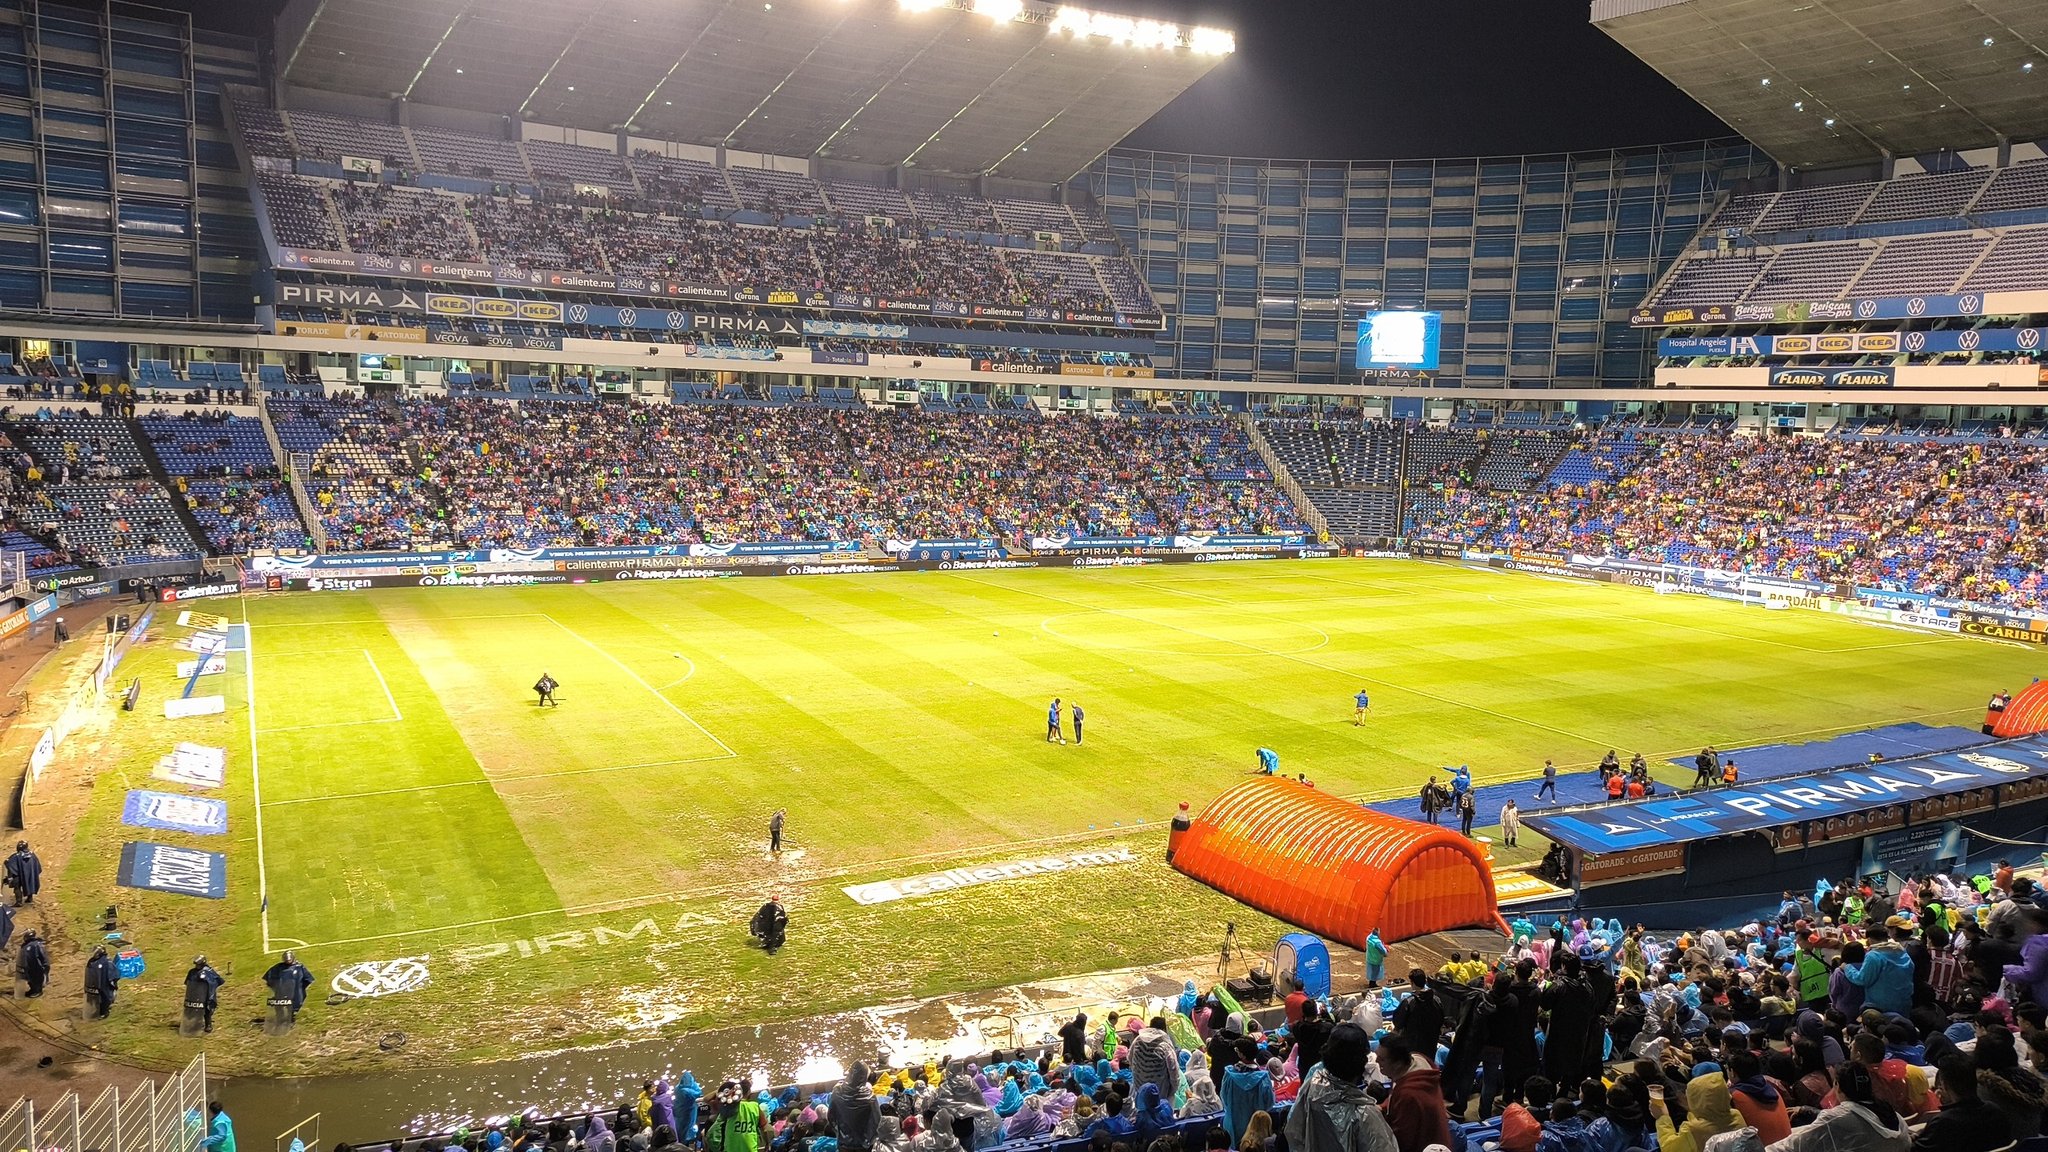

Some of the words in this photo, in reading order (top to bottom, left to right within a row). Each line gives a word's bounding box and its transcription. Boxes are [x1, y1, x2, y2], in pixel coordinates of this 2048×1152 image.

[309, 256, 355, 268] caliente.mx
[433, 263, 492, 281] caliente.mx
[562, 274, 616, 289] caliente.mx
[284, 287, 384, 306] PIRMA
[678, 284, 728, 298] caliente.mx
[735, 292, 760, 301] Corona
[432, 300, 470, 310] IKEA
[805, 297, 830, 306] Corona
[887, 300, 930, 313] caliente.mx
[479, 303, 514, 313] IKEA
[522, 306, 558, 316] IKEA
[982, 307, 1024, 319] caliente.mx
[1073, 313, 1114, 325] caliente.mx
[1132, 316, 1160, 326] caliente.mx
[1701, 312, 1726, 322] Corona
[695, 315, 770, 333] PIRMA
[523, 338, 556, 349] VEOVA
[1669, 339, 1697, 349] Hospital
[1699, 338, 1727, 348] Angeles
[1780, 340, 1808, 348] IKEA
[1820, 339, 1848, 347] IKEA
[1862, 338, 1893, 346] IKEA
[1365, 370, 1411, 378] PIRMA
[1838, 373, 1889, 385] FLANAX
[1780, 375, 1826, 385] FLANAX
[1082, 547, 1119, 555] PIRMA
[1141, 547, 1184, 556] caliente.mx
[1205, 553, 1233, 561] Banco
[1233, 552, 1258, 560] Azteca
[1364, 550, 1413, 559] caliente.mx
[1520, 550, 1564, 561] caliente.mx
[566, 559, 625, 570] caliente.mx
[626, 558, 676, 568] PIRMA
[953, 561, 986, 570] Banco
[986, 560, 1017, 568] Azteca
[1085, 556, 1114, 565] Banco
[1114, 555, 1142, 564] Azteca
[802, 563, 838, 574] Banco
[838, 562, 875, 572] Azteca
[1515, 562, 1543, 573] Banco
[1543, 566, 1574, 577] Azteca
[440, 574, 487, 586] Banco
[1619, 569, 1661, 580] PIRMA
[69, 574, 94, 587] Azteca
[324, 579, 372, 589] Steren
[176, 583, 238, 600] caliente.mx
[1908, 614, 1958, 629] STARS
[1723, 775, 1923, 816] PIRMA
[1584, 857, 1625, 872] GATORADE
[1639, 849, 1678, 864] GATORADE
[899, 846, 1136, 894] caliente.mx
[452, 911, 725, 959] PIRMA
